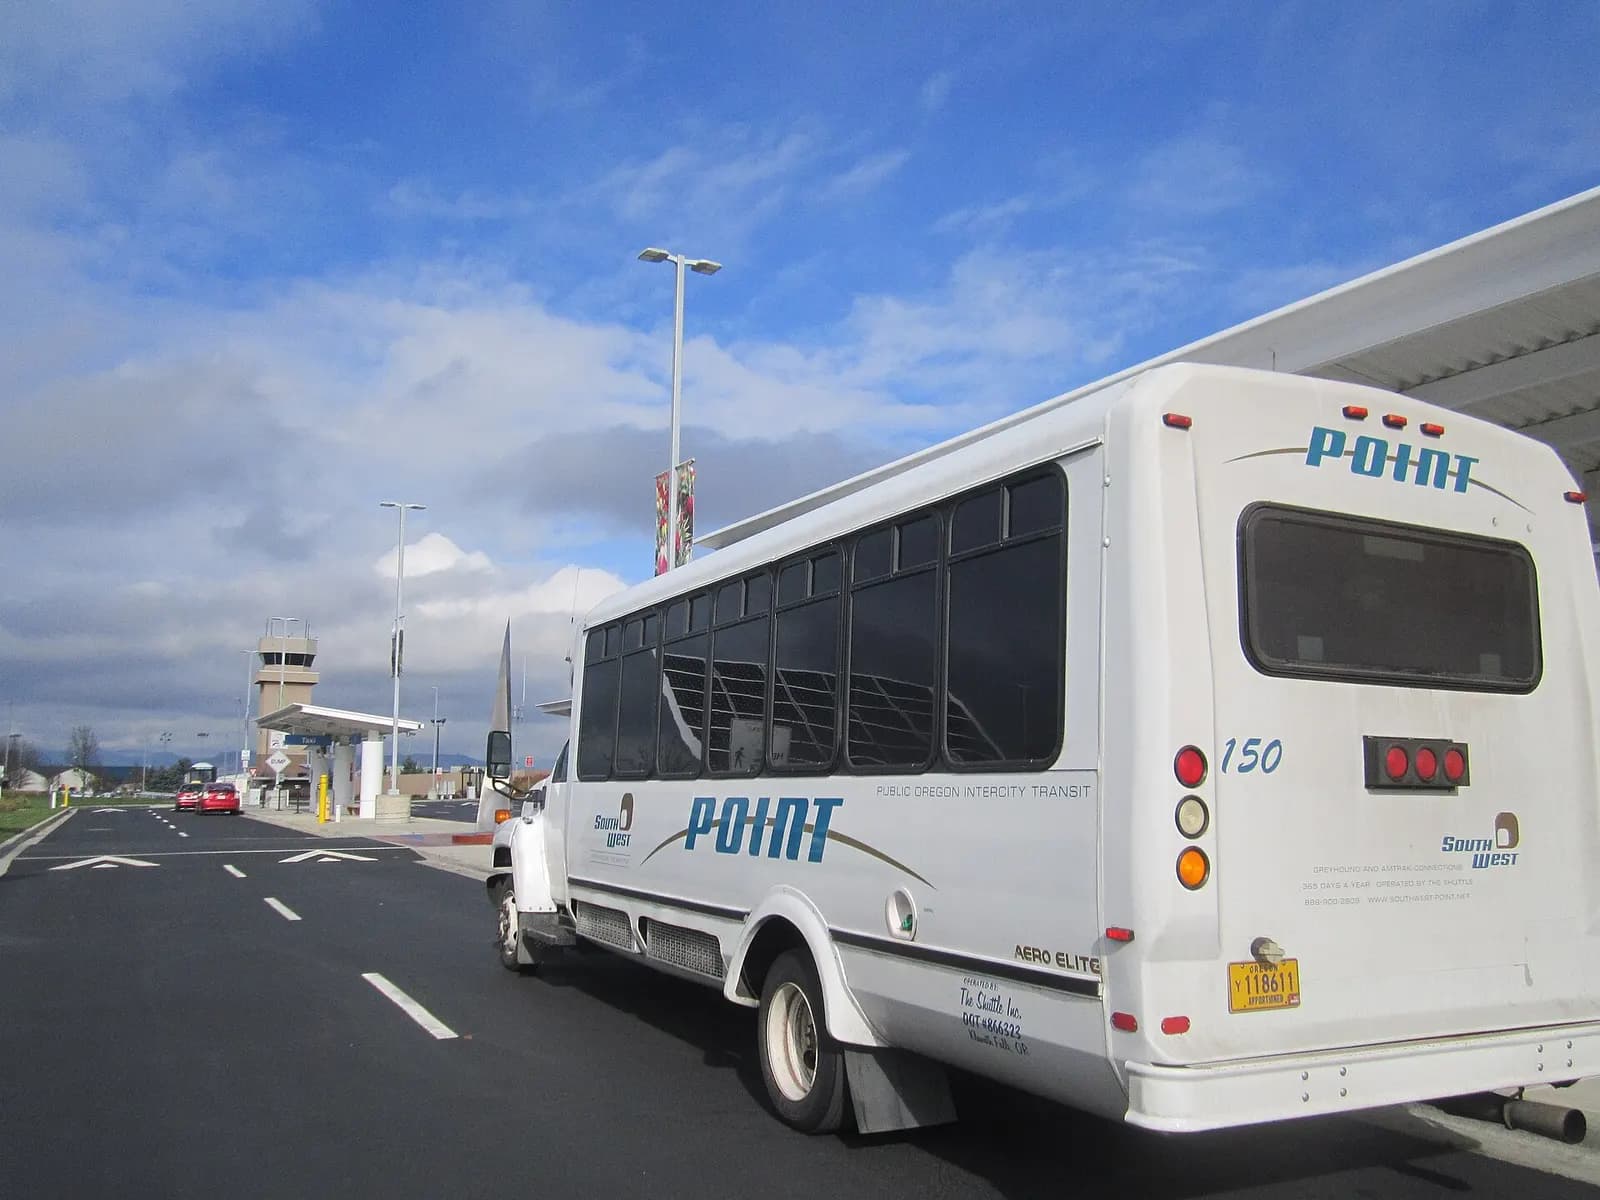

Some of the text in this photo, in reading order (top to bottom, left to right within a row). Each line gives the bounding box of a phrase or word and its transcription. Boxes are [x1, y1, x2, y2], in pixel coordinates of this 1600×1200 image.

[1305, 426, 1480, 494] POINT
[1221, 737, 1283, 774] 150
[876, 785, 1092, 798] PUBLIC OREGON INTERCITY TRANSIT
[684, 797, 845, 864] POINT
[1313, 866, 1361, 874] GREYHOUND
[1363, 865, 1379, 873] AND
[1381, 864, 1413, 873] AMTRAK
[1303, 882, 1319, 890] 365
[1351, 881, 1370, 889] YEAR
[1375, 880, 1415, 888] OPERATED
[1415, 879, 1426, 887] BY
[1014, 944, 1101, 974] AERO ELITE
[1235, 971, 1294, 995] Y 118611
[961, 987, 1022, 1020] The Shuttle Inc.
